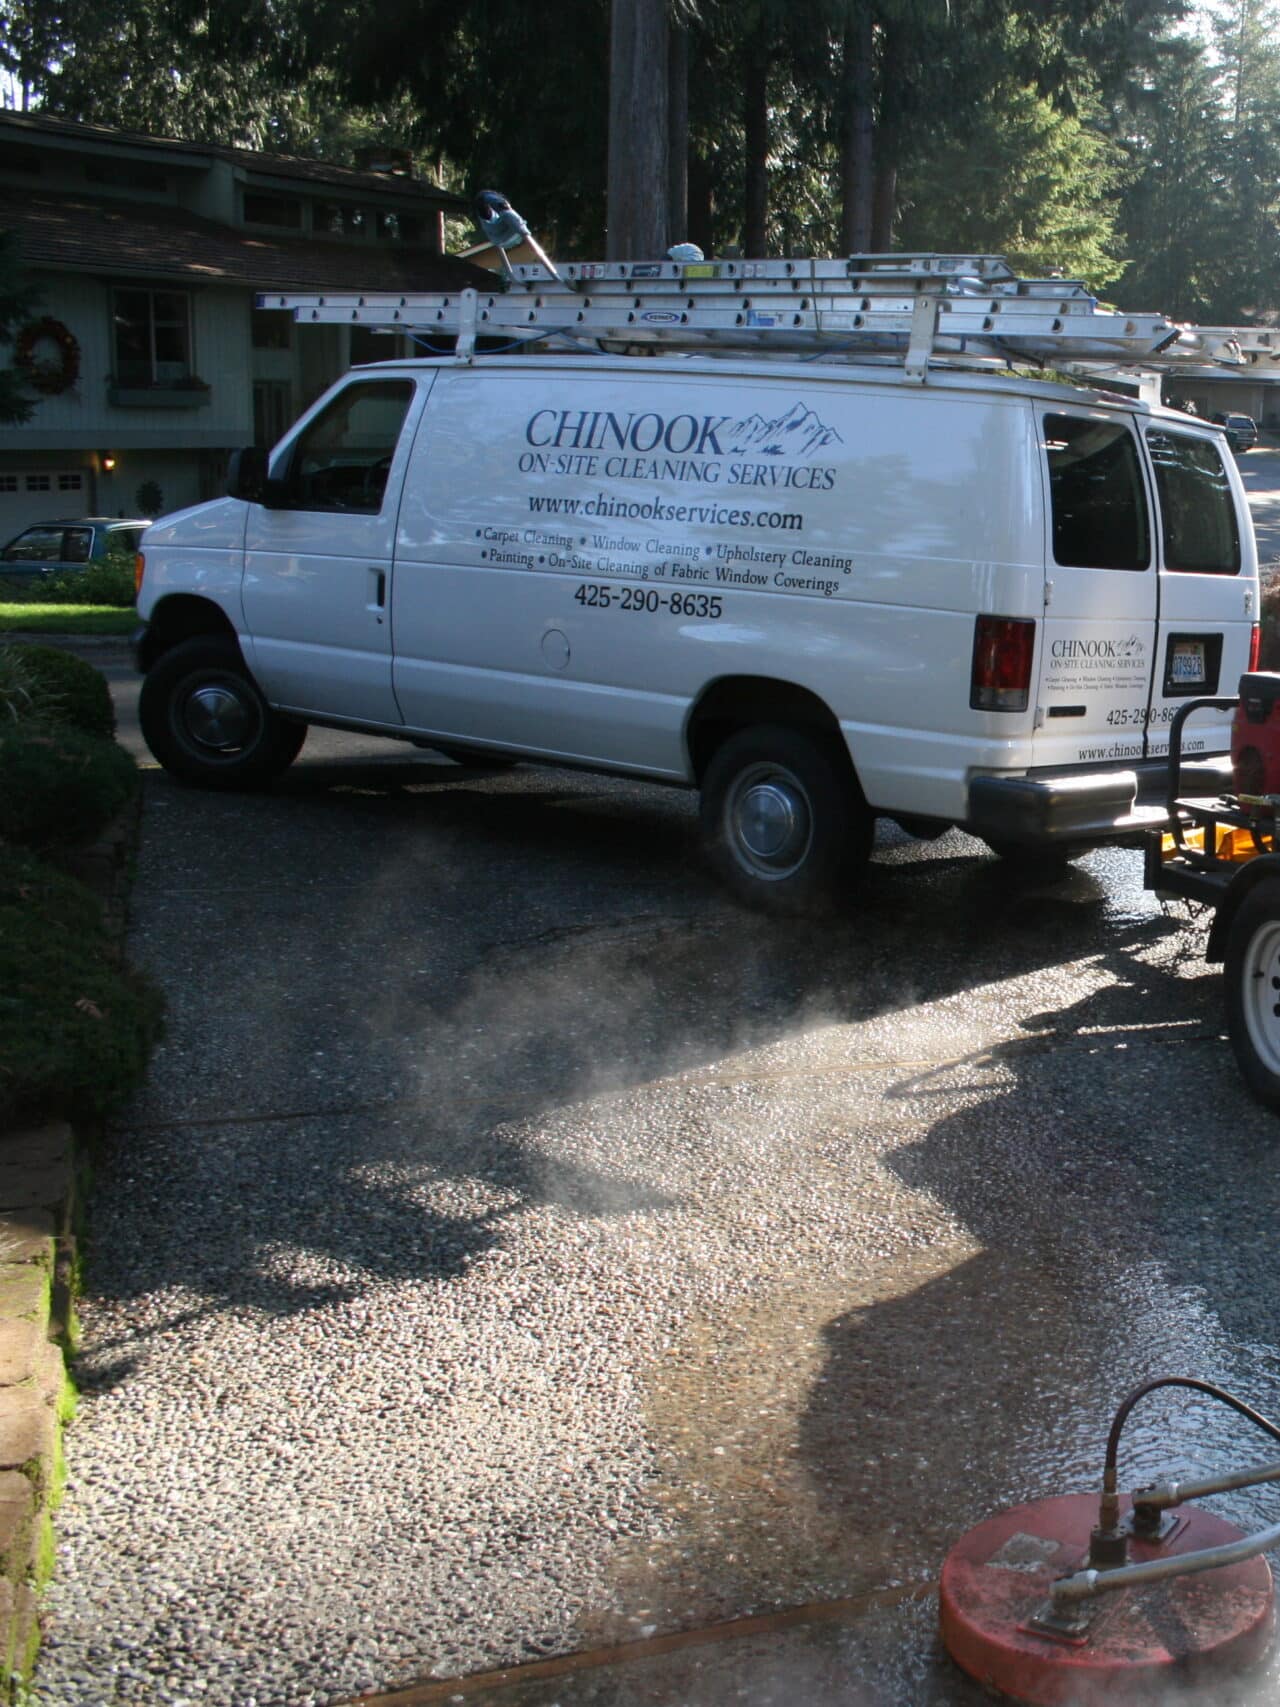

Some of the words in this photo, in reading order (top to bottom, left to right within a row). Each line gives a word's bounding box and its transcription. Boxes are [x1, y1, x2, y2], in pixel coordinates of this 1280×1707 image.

[526, 409, 732, 456] CHINOOK
[518, 452, 599, 476] ON-SITE
[604, 457, 721, 484] CLEANING
[728, 463, 837, 490] SERVICES
[528, 493, 803, 530] www.chinookservices.com
[483, 527, 519, 545] Carpet
[523, 530, 573, 551] Cleaning
[592, 535, 641, 552] Window
[646, 539, 700, 562] Cleaning
[716, 544, 787, 569] Upholstery
[791, 550, 852, 574] Cleaning
[489, 549, 534, 569] Painting
[548, 553, 592, 571] On-Site
[597, 557, 649, 579] Cleaning
[654, 561, 667, 577] of
[671, 562, 709, 580] Fabric
[716, 567, 768, 585] Window
[773, 571, 839, 596] Coverings
[574, 584, 723, 619] 425-290-8635
[1051, 639, 1116, 657] CHINOOK
